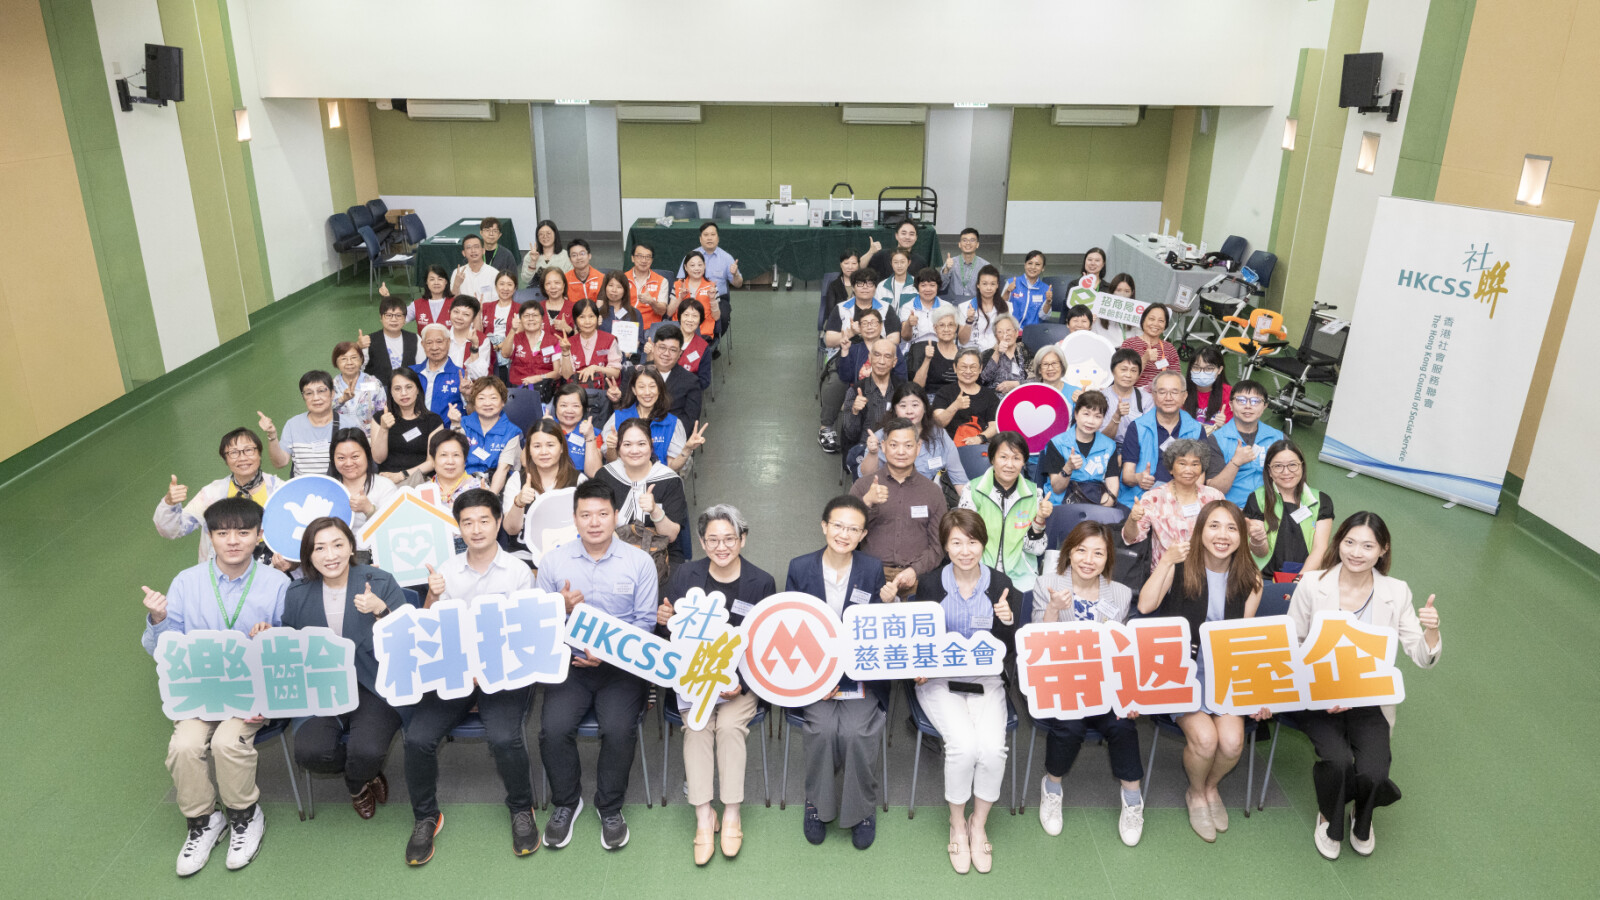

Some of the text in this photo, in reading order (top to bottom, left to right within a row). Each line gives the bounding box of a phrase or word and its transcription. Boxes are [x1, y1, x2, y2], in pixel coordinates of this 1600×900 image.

[1398, 269, 1472, 298] HKCSS
[1462, 243, 1510, 319] 社聯
[1399, 315, 1441, 461] The Hong Kong Council of Social Service
[1424, 316, 1454, 408] 香港社會服務聯會
[382, 597, 564, 697] 科技
[569, 611, 681, 680] HKCSS
[674, 594, 742, 723] 社聯
[853, 613, 935, 640] 招商局
[854, 639, 997, 671] 慈善基金會
[1209, 619, 1395, 706] 屋企
[163, 635, 349, 713] 樂齡
[1024, 625, 1193, 711] 帶返
